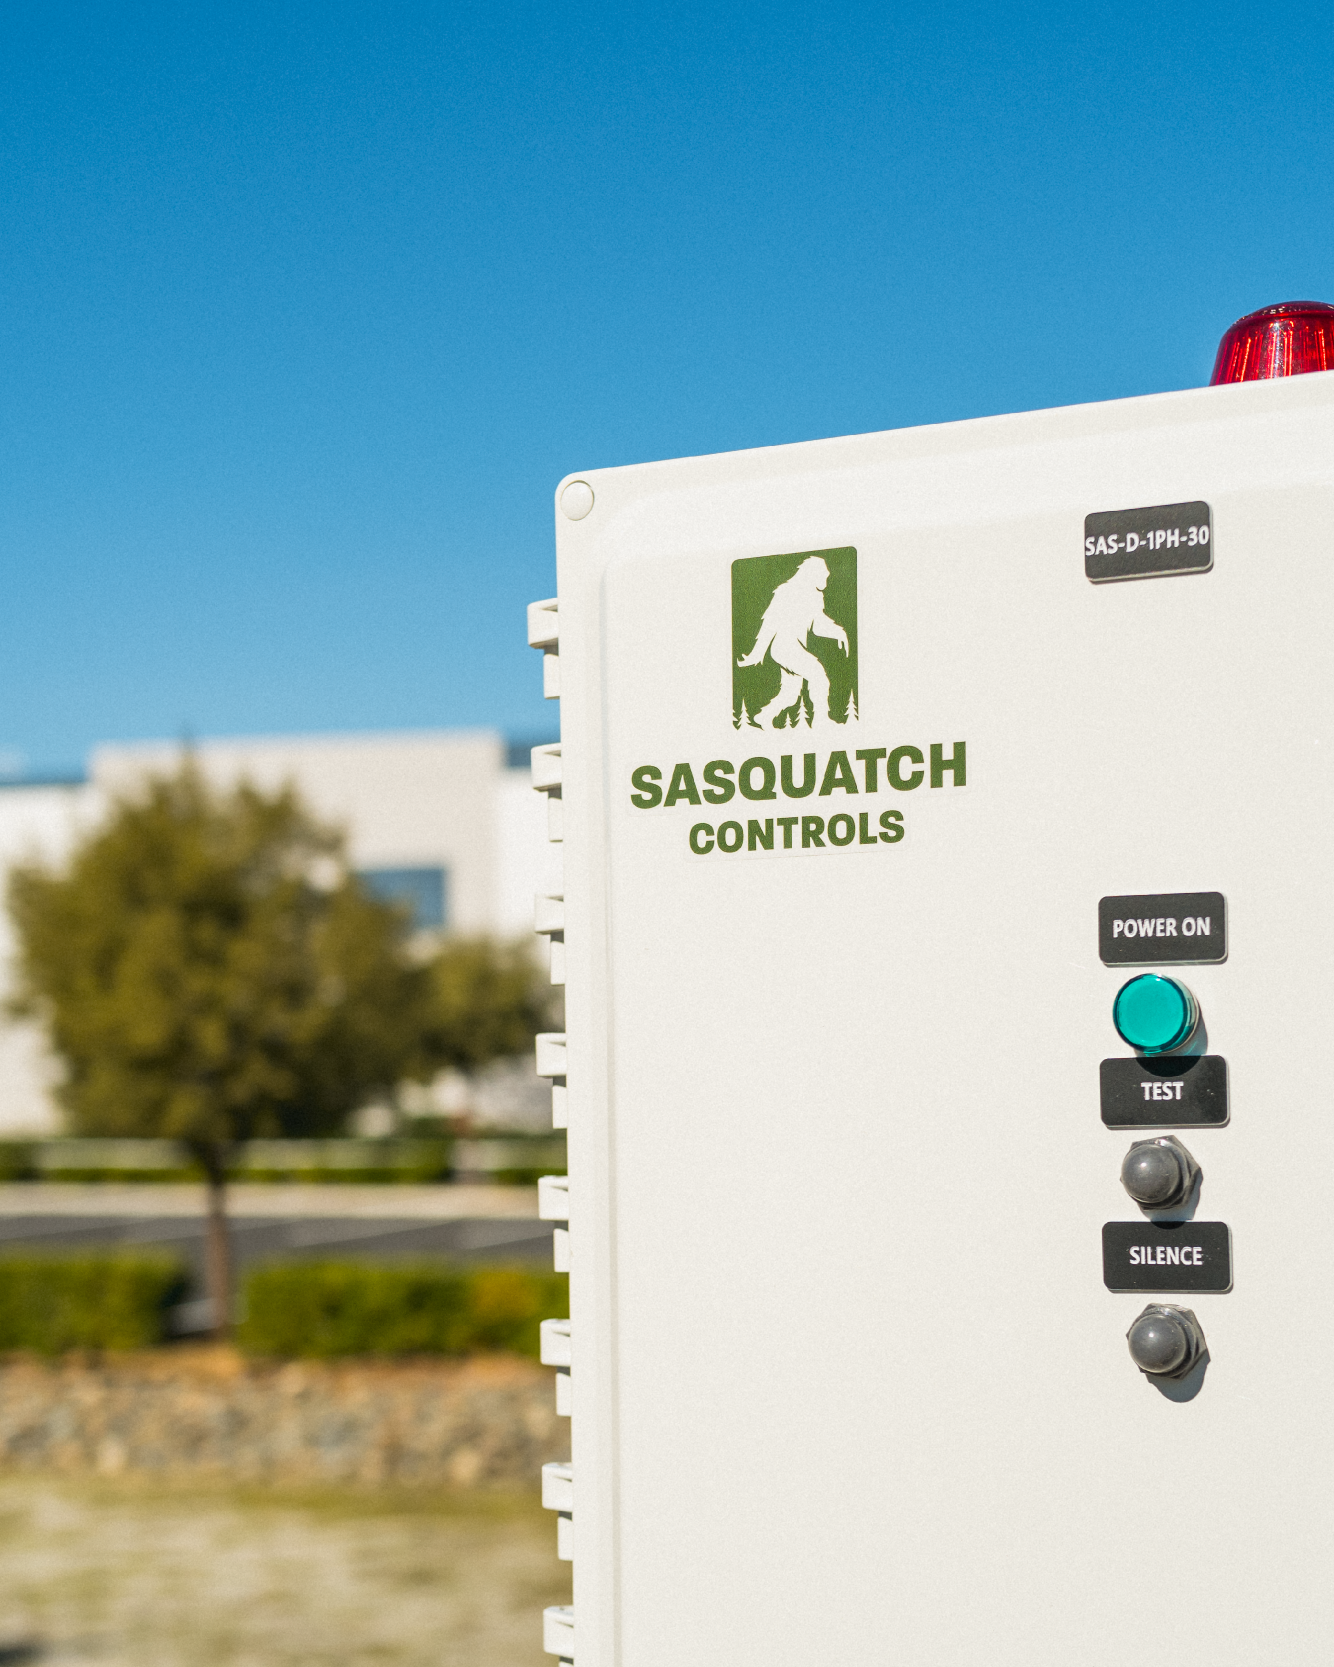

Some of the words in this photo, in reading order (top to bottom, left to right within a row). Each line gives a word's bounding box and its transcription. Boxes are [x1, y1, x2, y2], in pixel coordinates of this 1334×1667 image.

[1085, 524, 1210, 556] SAS-D-1PH-30
[630, 741, 967, 810] SASQUATCH
[688, 809, 906, 856] CONTROLS
[1112, 917, 1177, 939] POWER
[1181, 916, 1211, 937] ON
[1140, 1080, 1185, 1101] TEST
[1128, 1245, 1203, 1266] SILENCE
